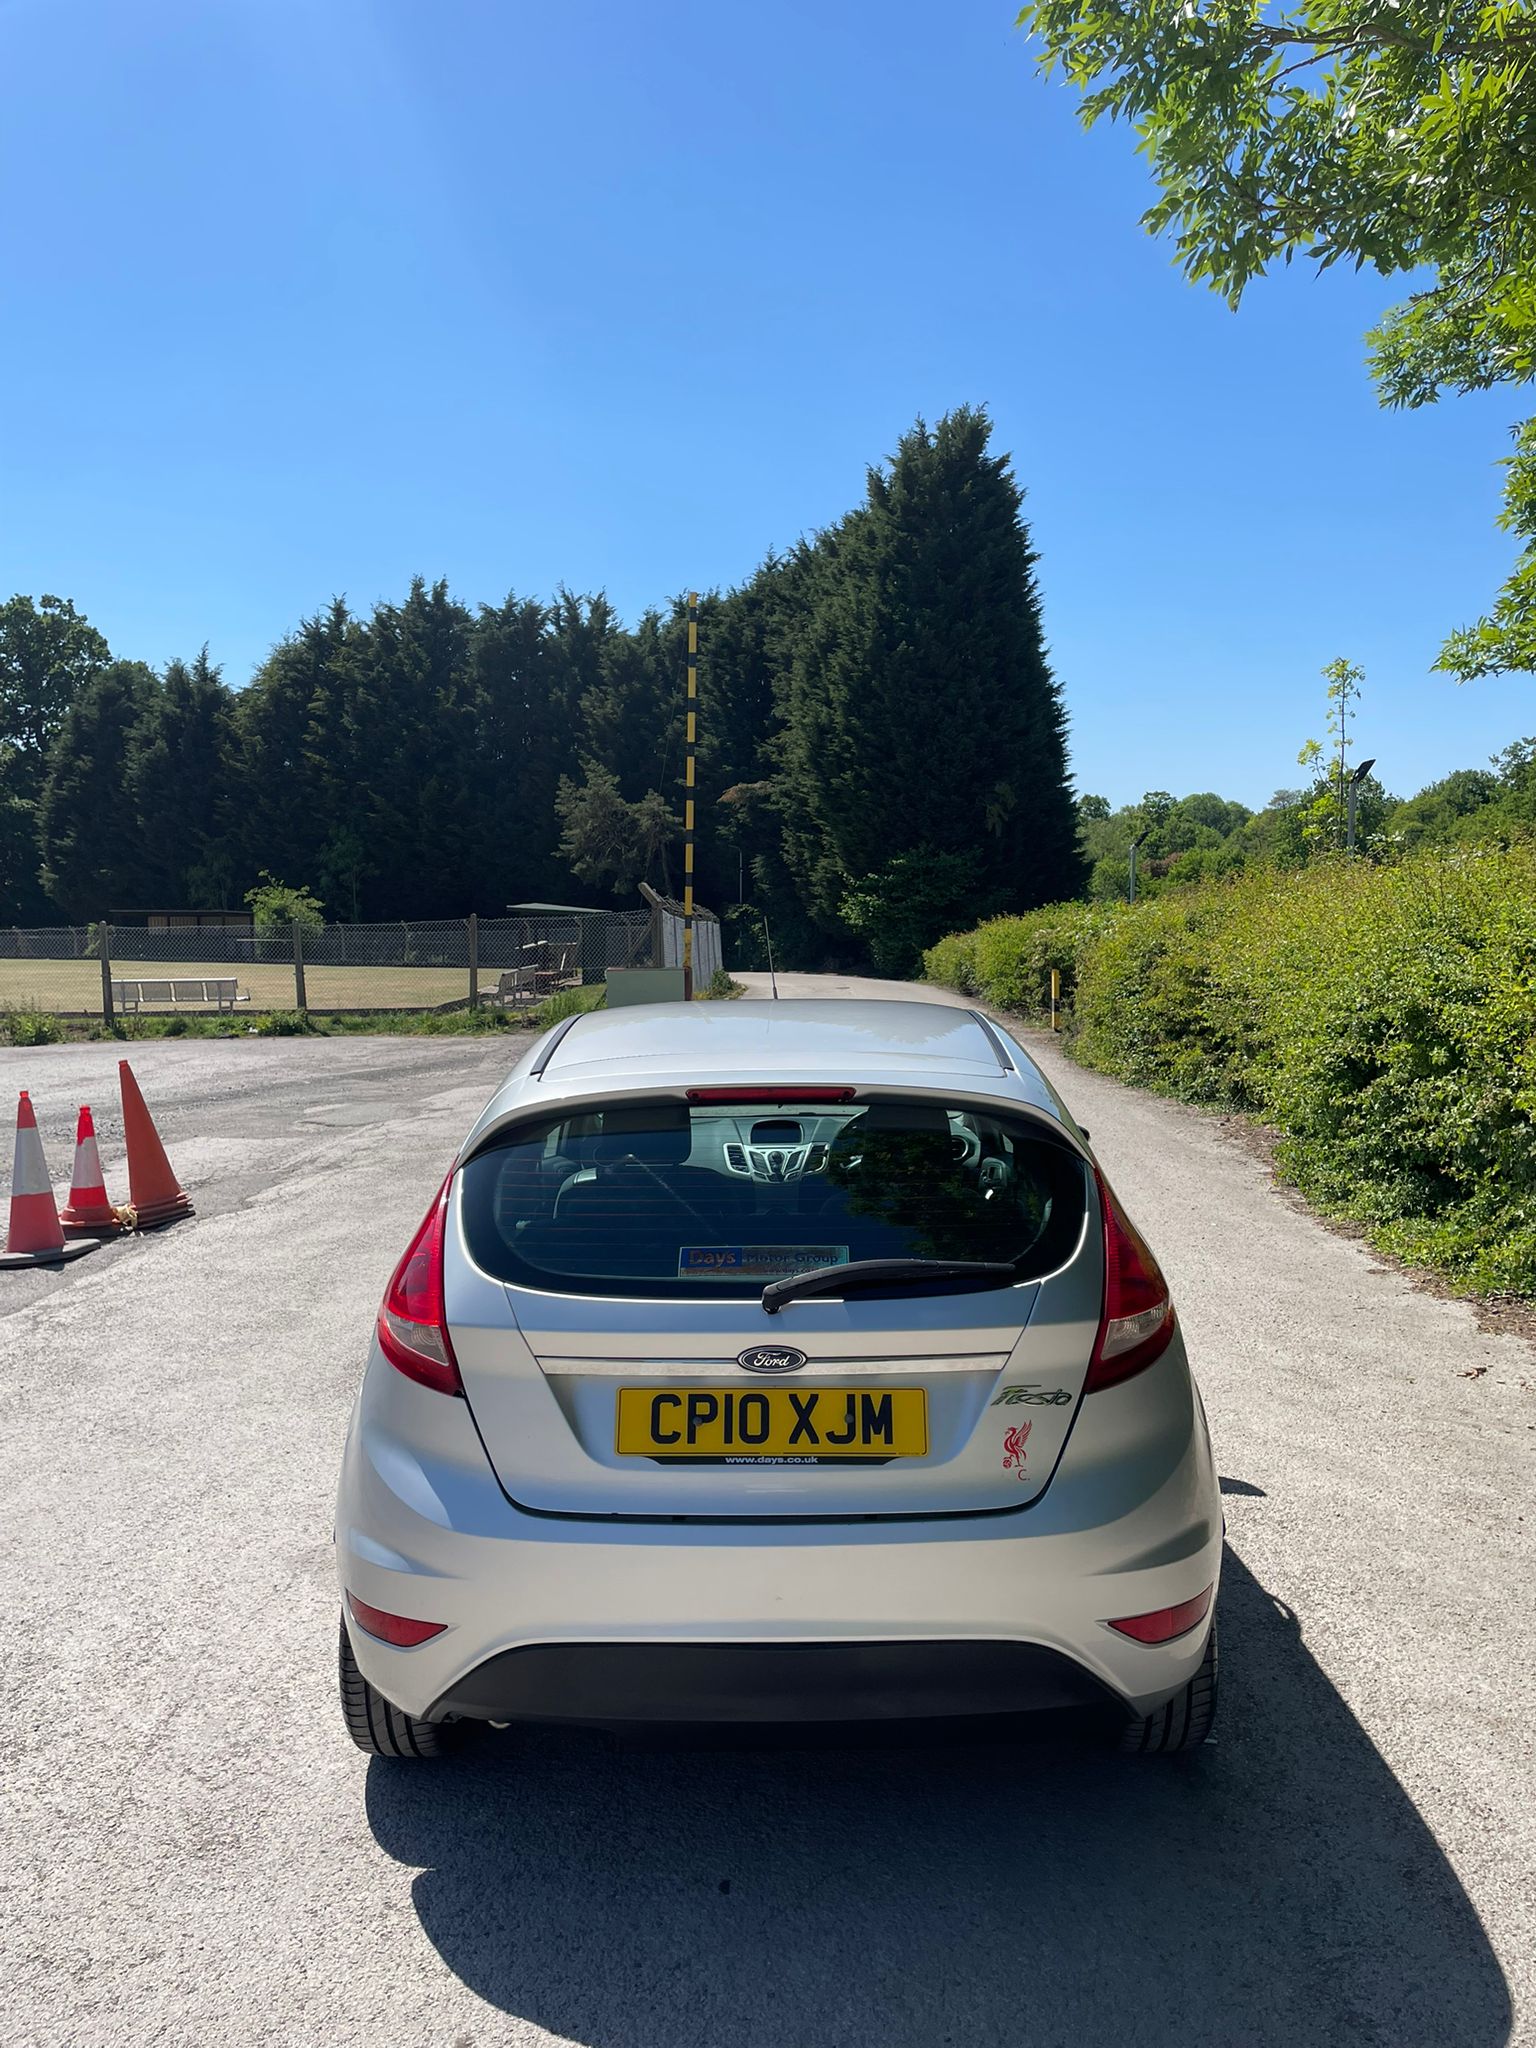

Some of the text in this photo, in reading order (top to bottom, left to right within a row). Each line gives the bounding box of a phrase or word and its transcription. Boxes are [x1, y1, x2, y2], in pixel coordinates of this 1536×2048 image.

[688, 1250, 736, 1267] Days
[795, 1253, 839, 1265] Group
[753, 1351, 791, 1367] Ford
[990, 1384, 1073, 1407] Fiesta
[650, 1393, 894, 1445] CP10 XJM
[724, 1456, 818, 1466] www.days.co.uk
